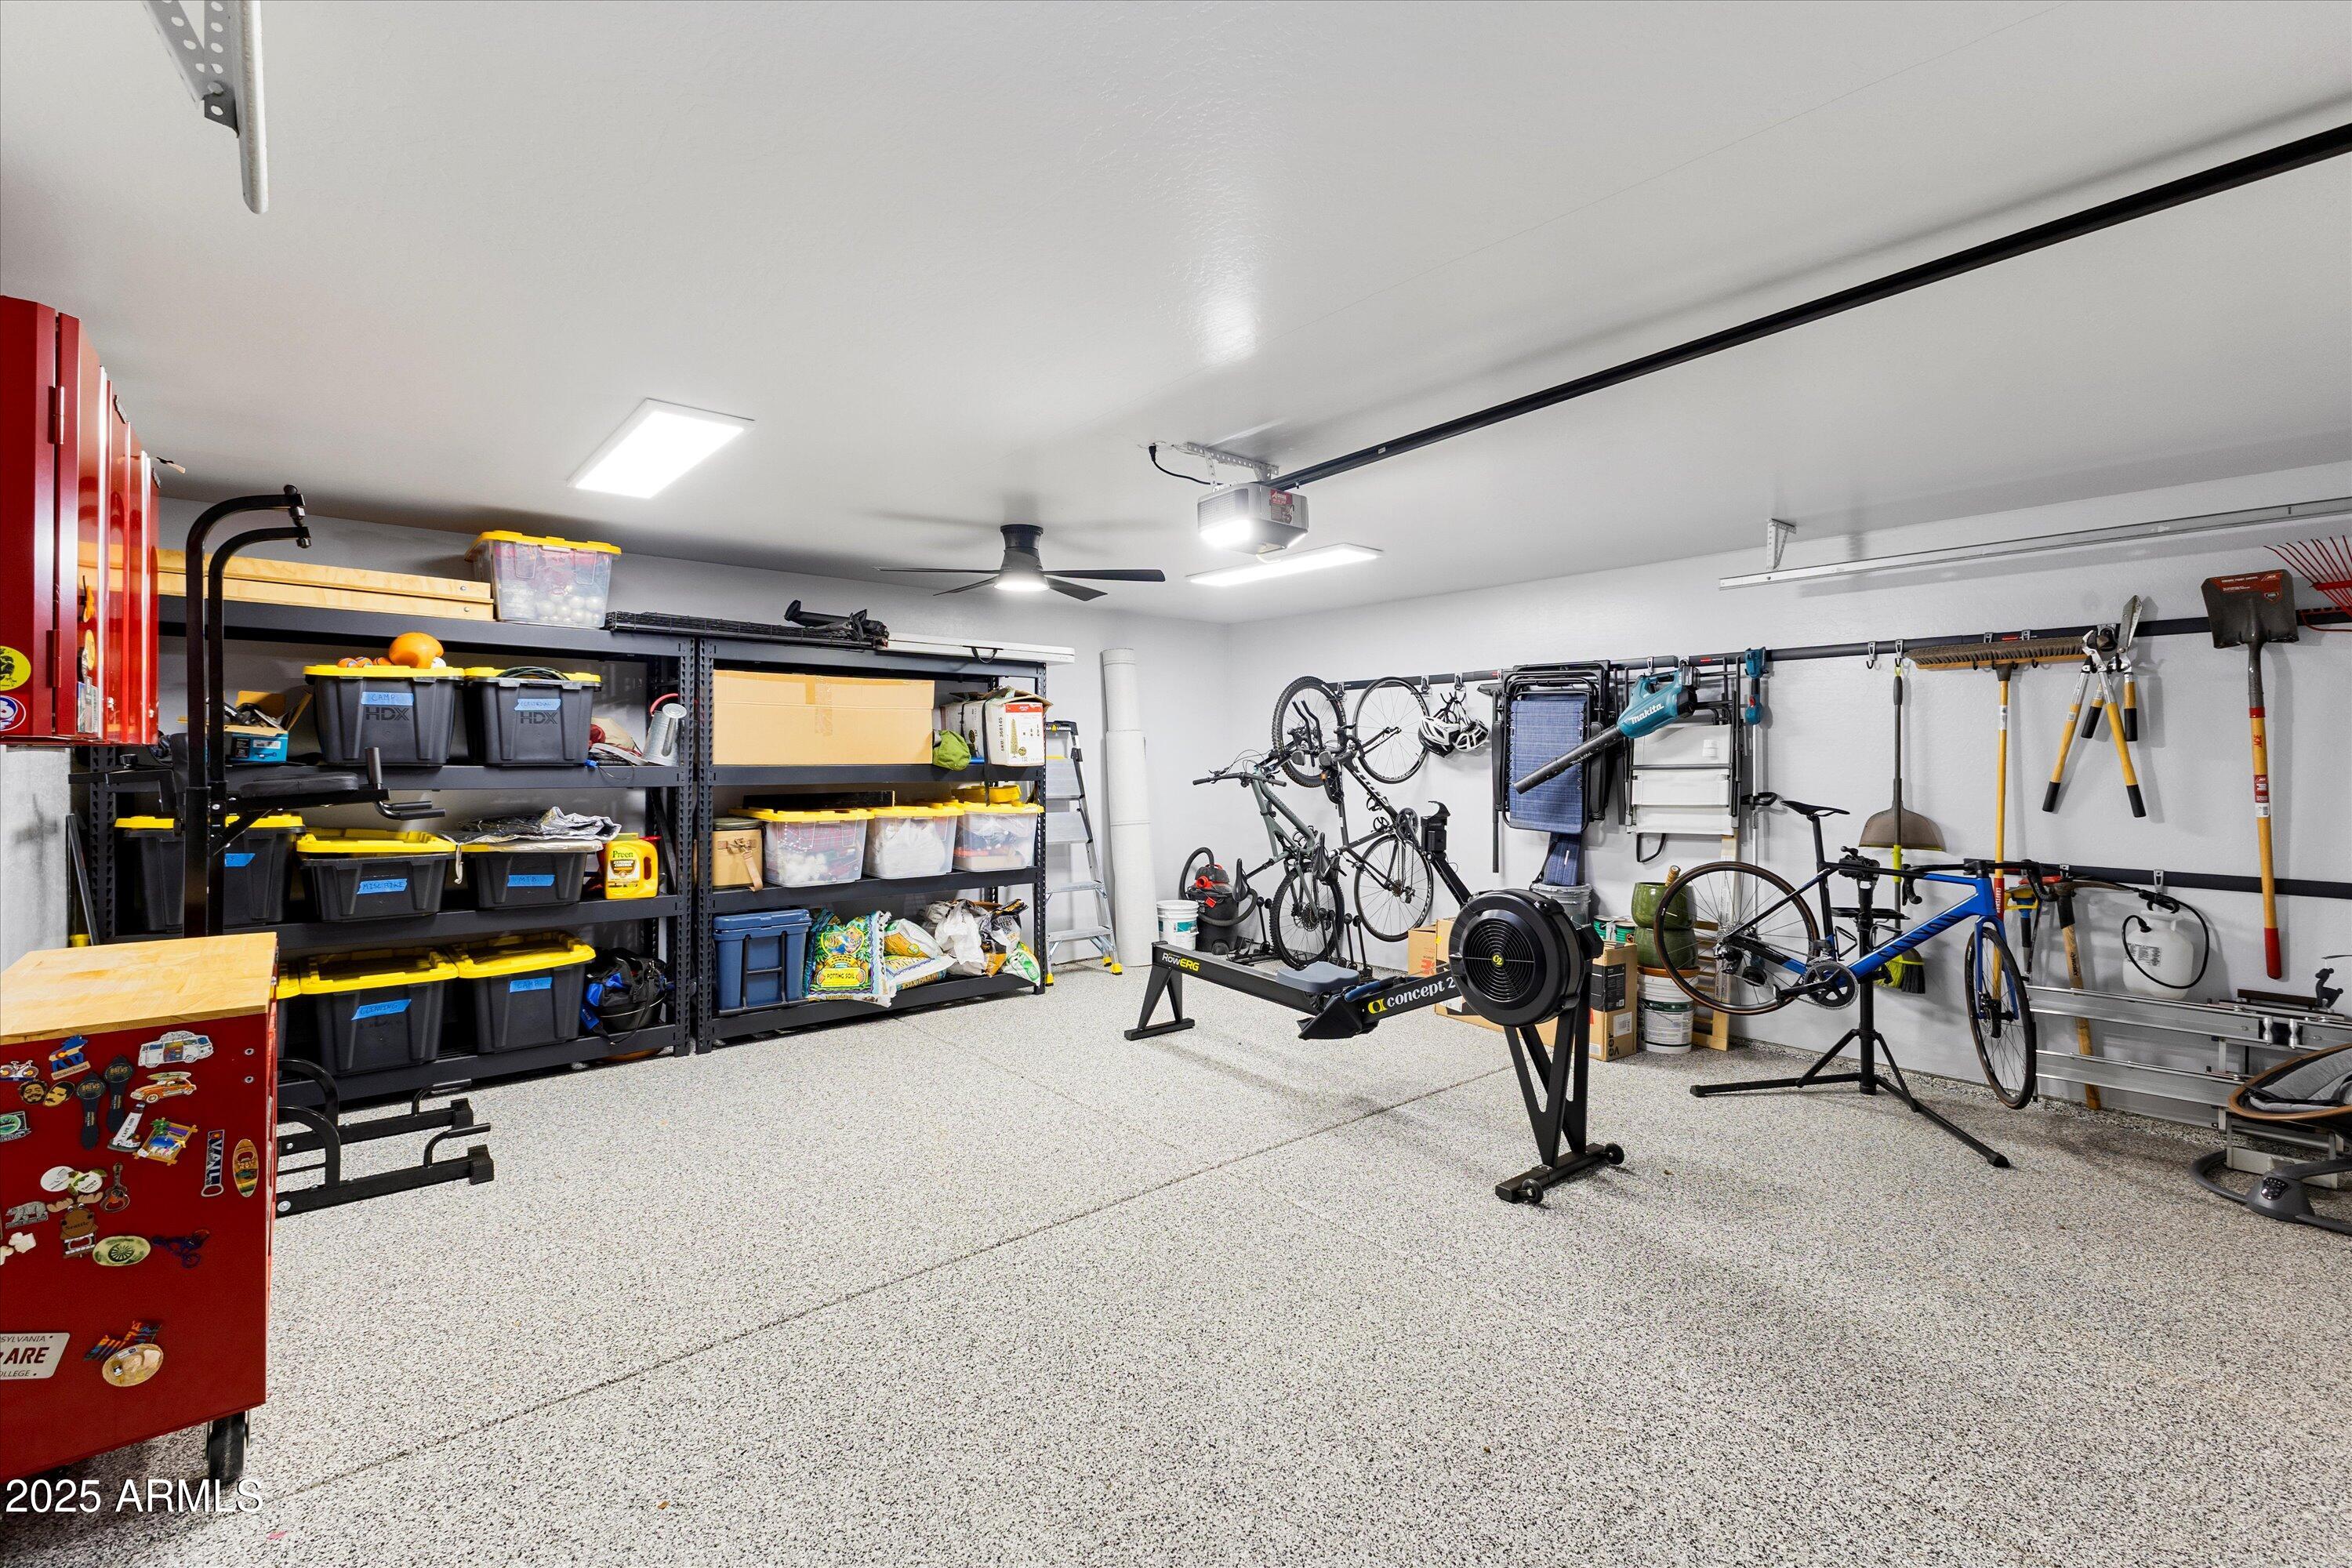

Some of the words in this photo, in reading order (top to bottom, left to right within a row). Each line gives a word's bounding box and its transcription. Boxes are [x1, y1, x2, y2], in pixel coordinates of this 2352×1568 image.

[371, 693, 396, 702] CAMP
[365, 706, 410, 721] HDX
[520, 711, 558, 724] HDX
[1624, 702, 1664, 724] Makita
[2253, 734, 2263, 748] ACE
[612, 850, 633, 858] Preen
[1386, 980, 1445, 1008] concept
[1446, 976, 1456, 989] 2
[110, 1067, 129, 1076] BREWS
[208, 1138, 223, 1185] VAIL
[2, 1346, 50, 1365] ARE
